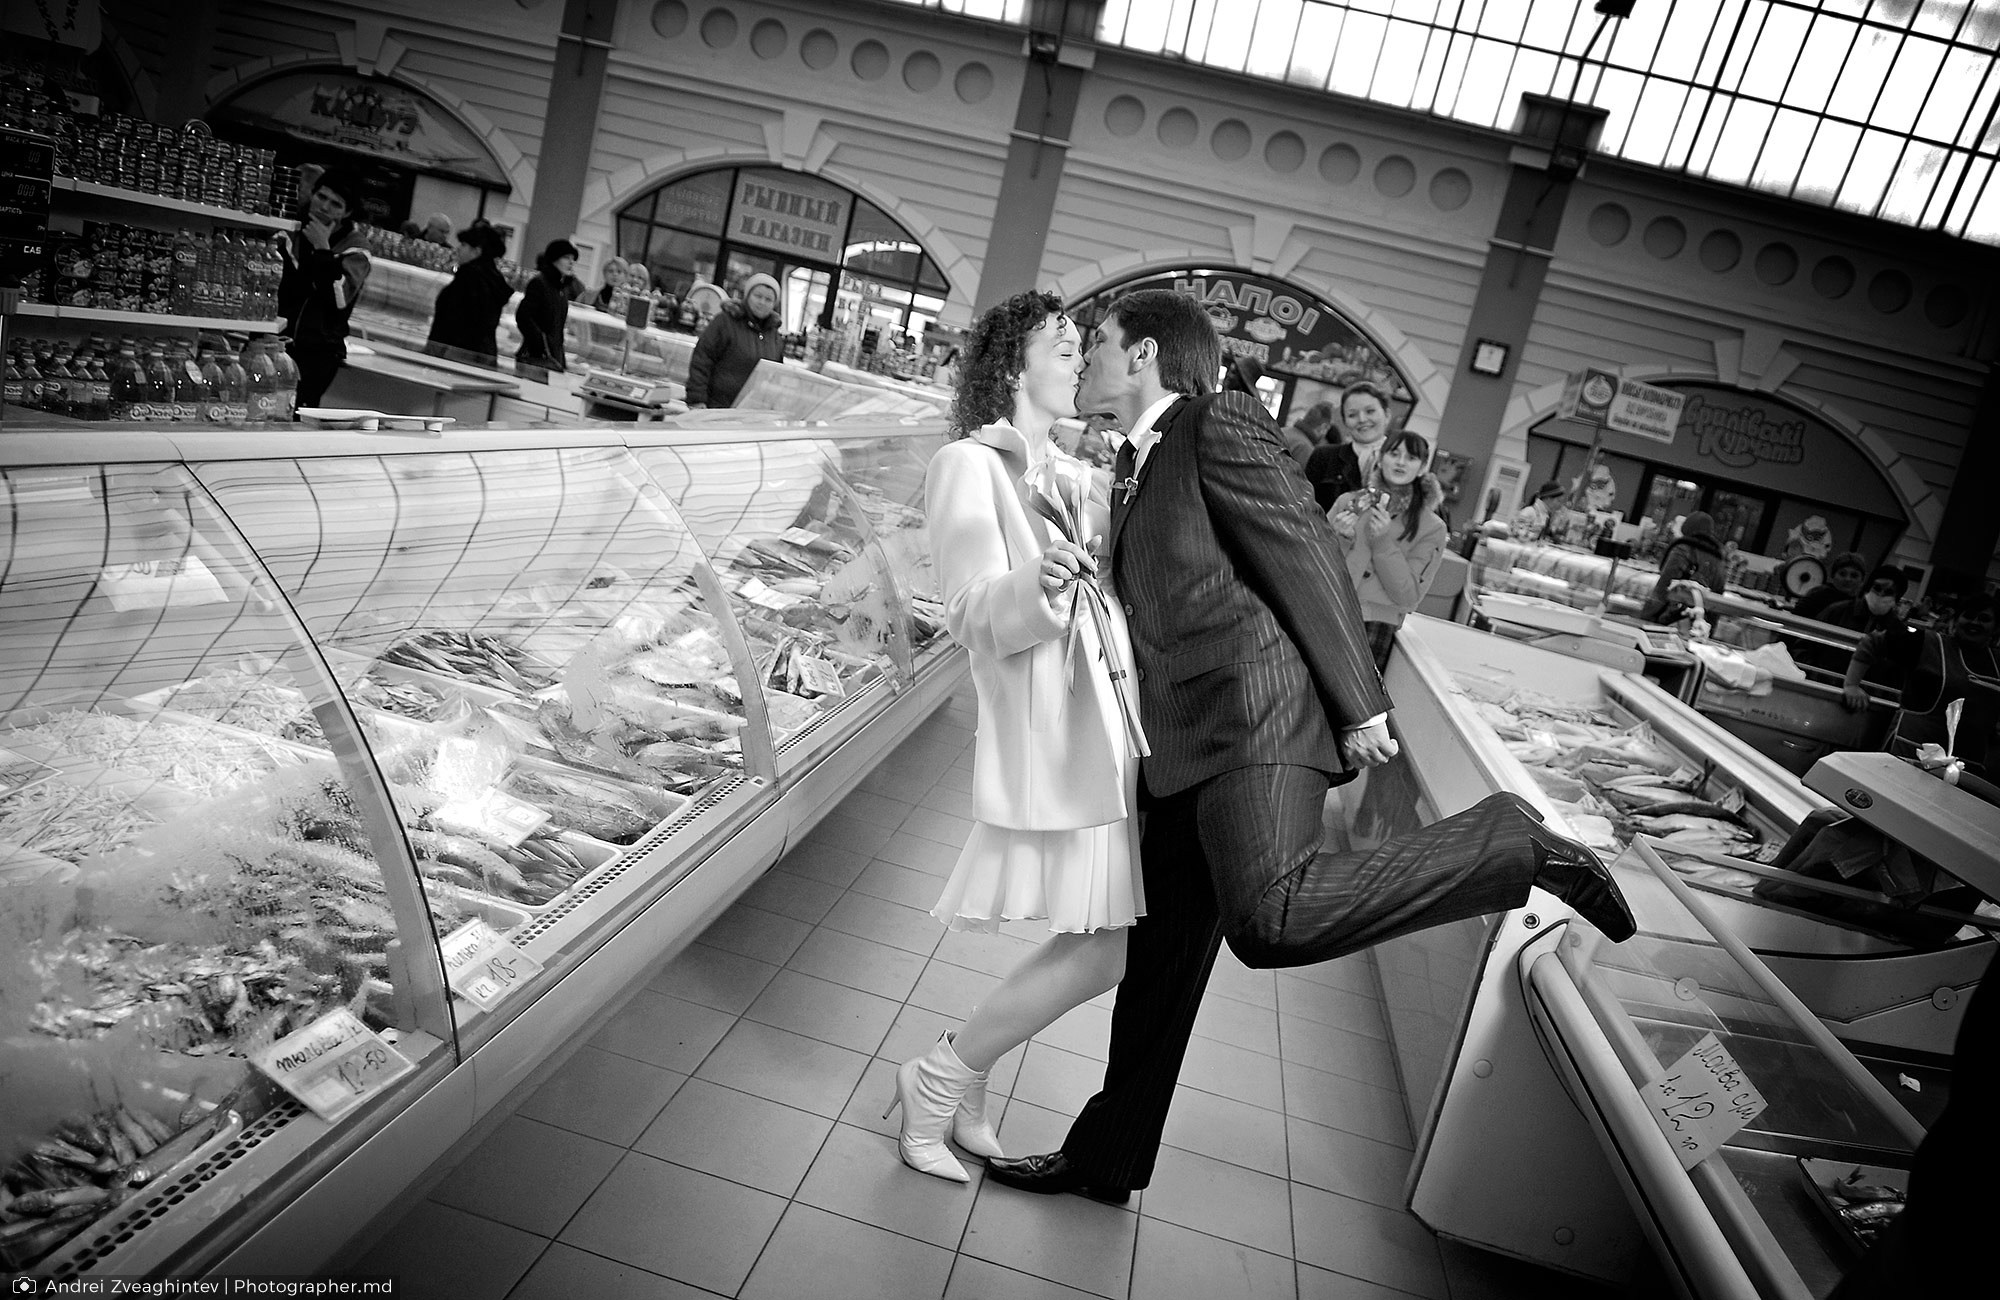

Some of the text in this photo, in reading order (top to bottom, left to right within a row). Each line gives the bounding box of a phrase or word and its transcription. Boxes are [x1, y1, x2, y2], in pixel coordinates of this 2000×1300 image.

[741, 182, 842, 226] РЫБНЫЙ
[23, 245, 42, 255] CAS
[740, 214, 832, 253] МАГАЗИН
[1698, 424, 1804, 468] Курчата
[1661, 1091, 1715, 1132] 12
